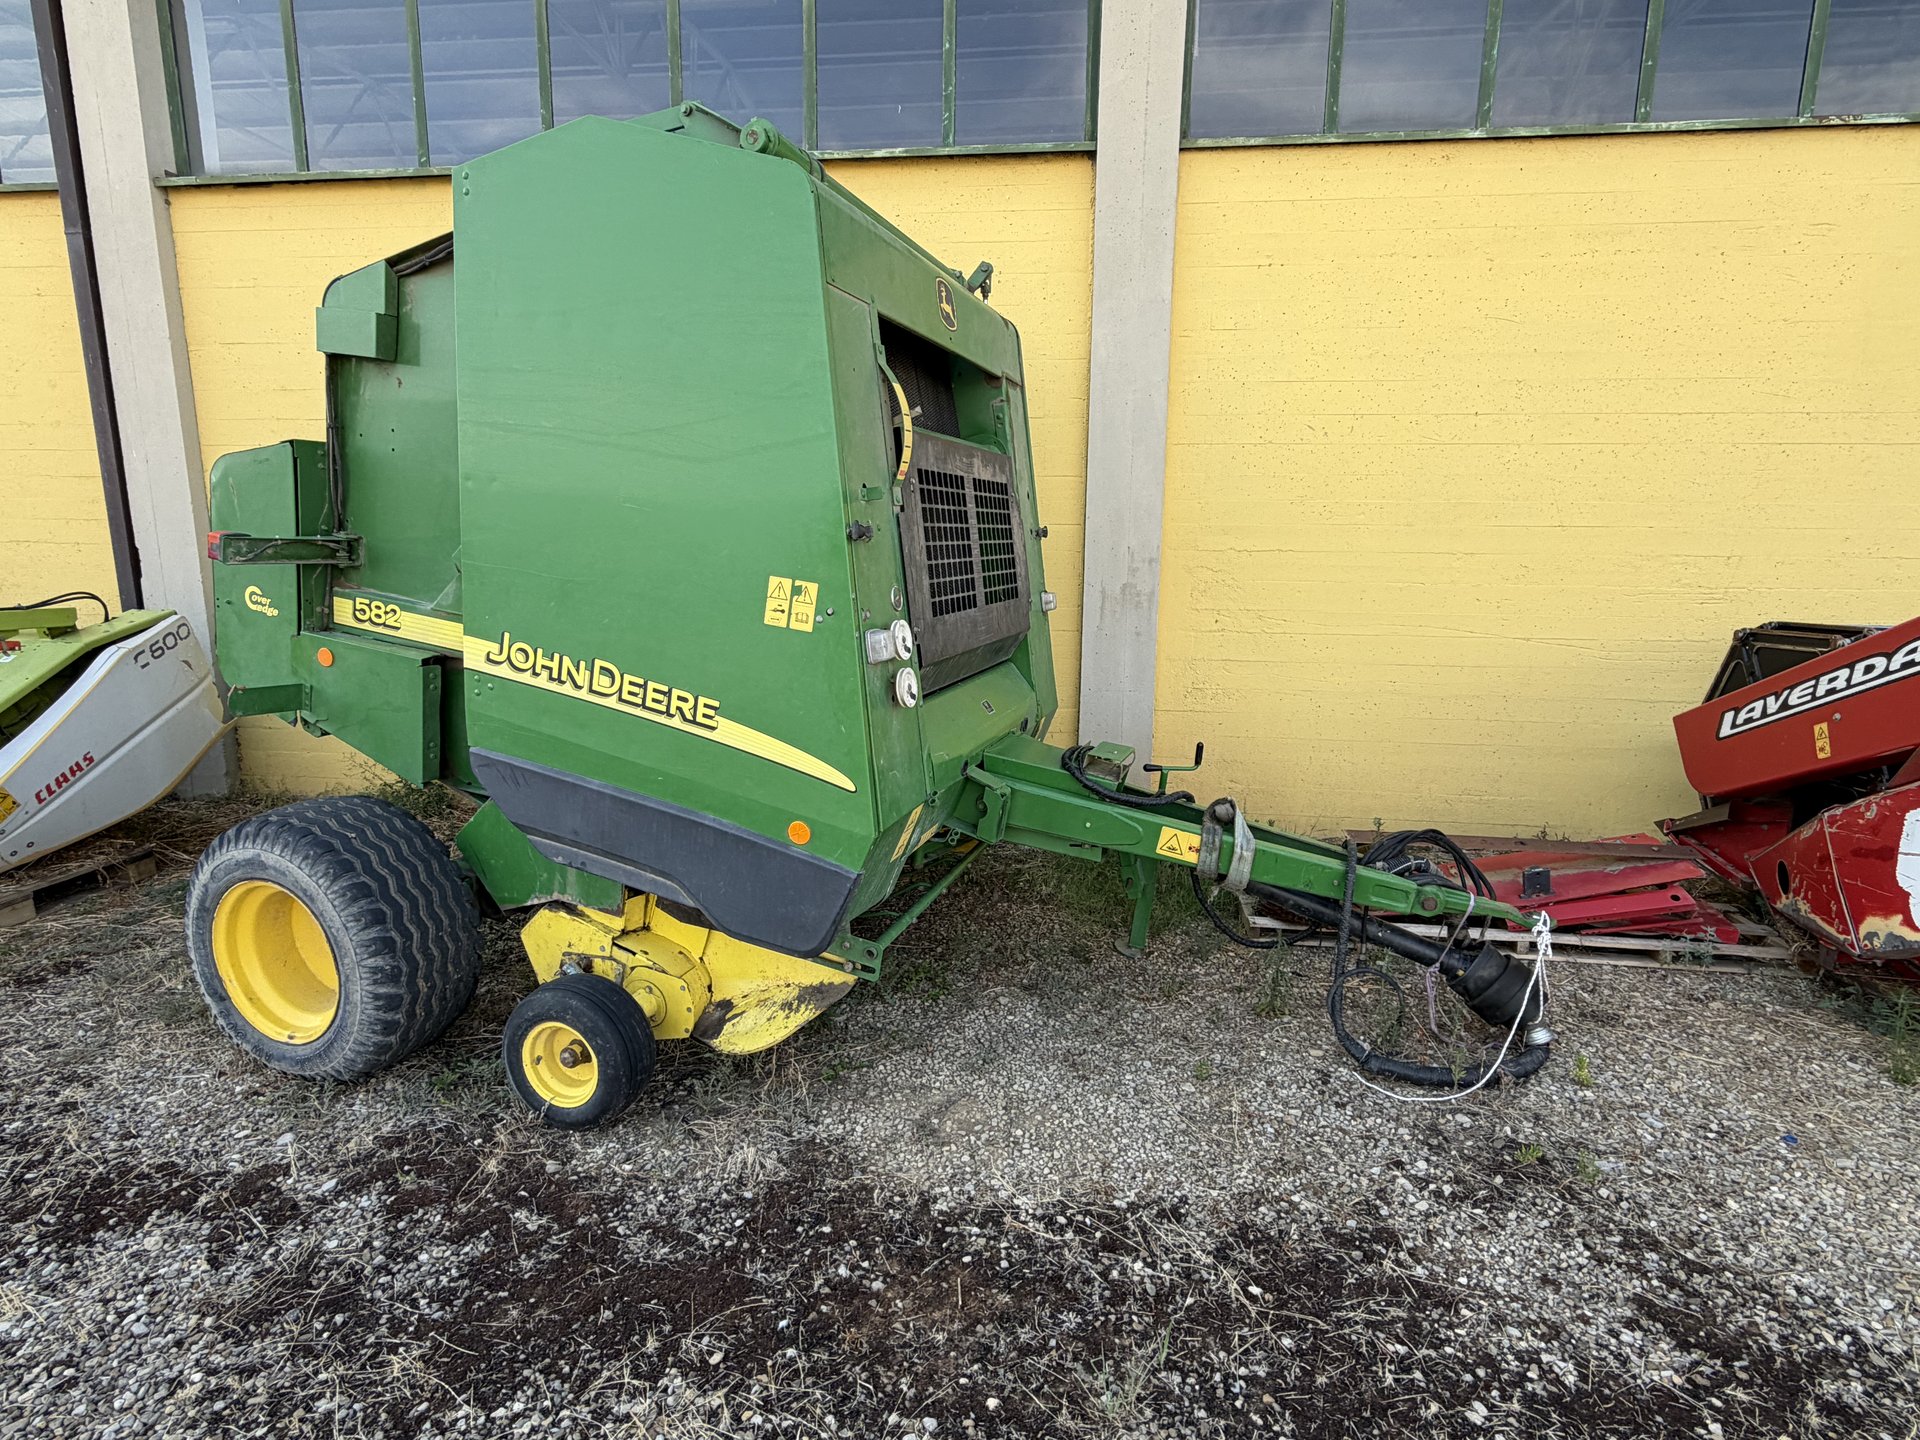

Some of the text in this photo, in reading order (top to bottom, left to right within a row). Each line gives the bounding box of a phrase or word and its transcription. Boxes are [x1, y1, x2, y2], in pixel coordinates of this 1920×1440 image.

[354, 597, 401, 630] 582
[133, 622, 190, 669] C600
[485, 631, 720, 731] JOHN DEERE
[35, 751, 95, 805] CLAAS
